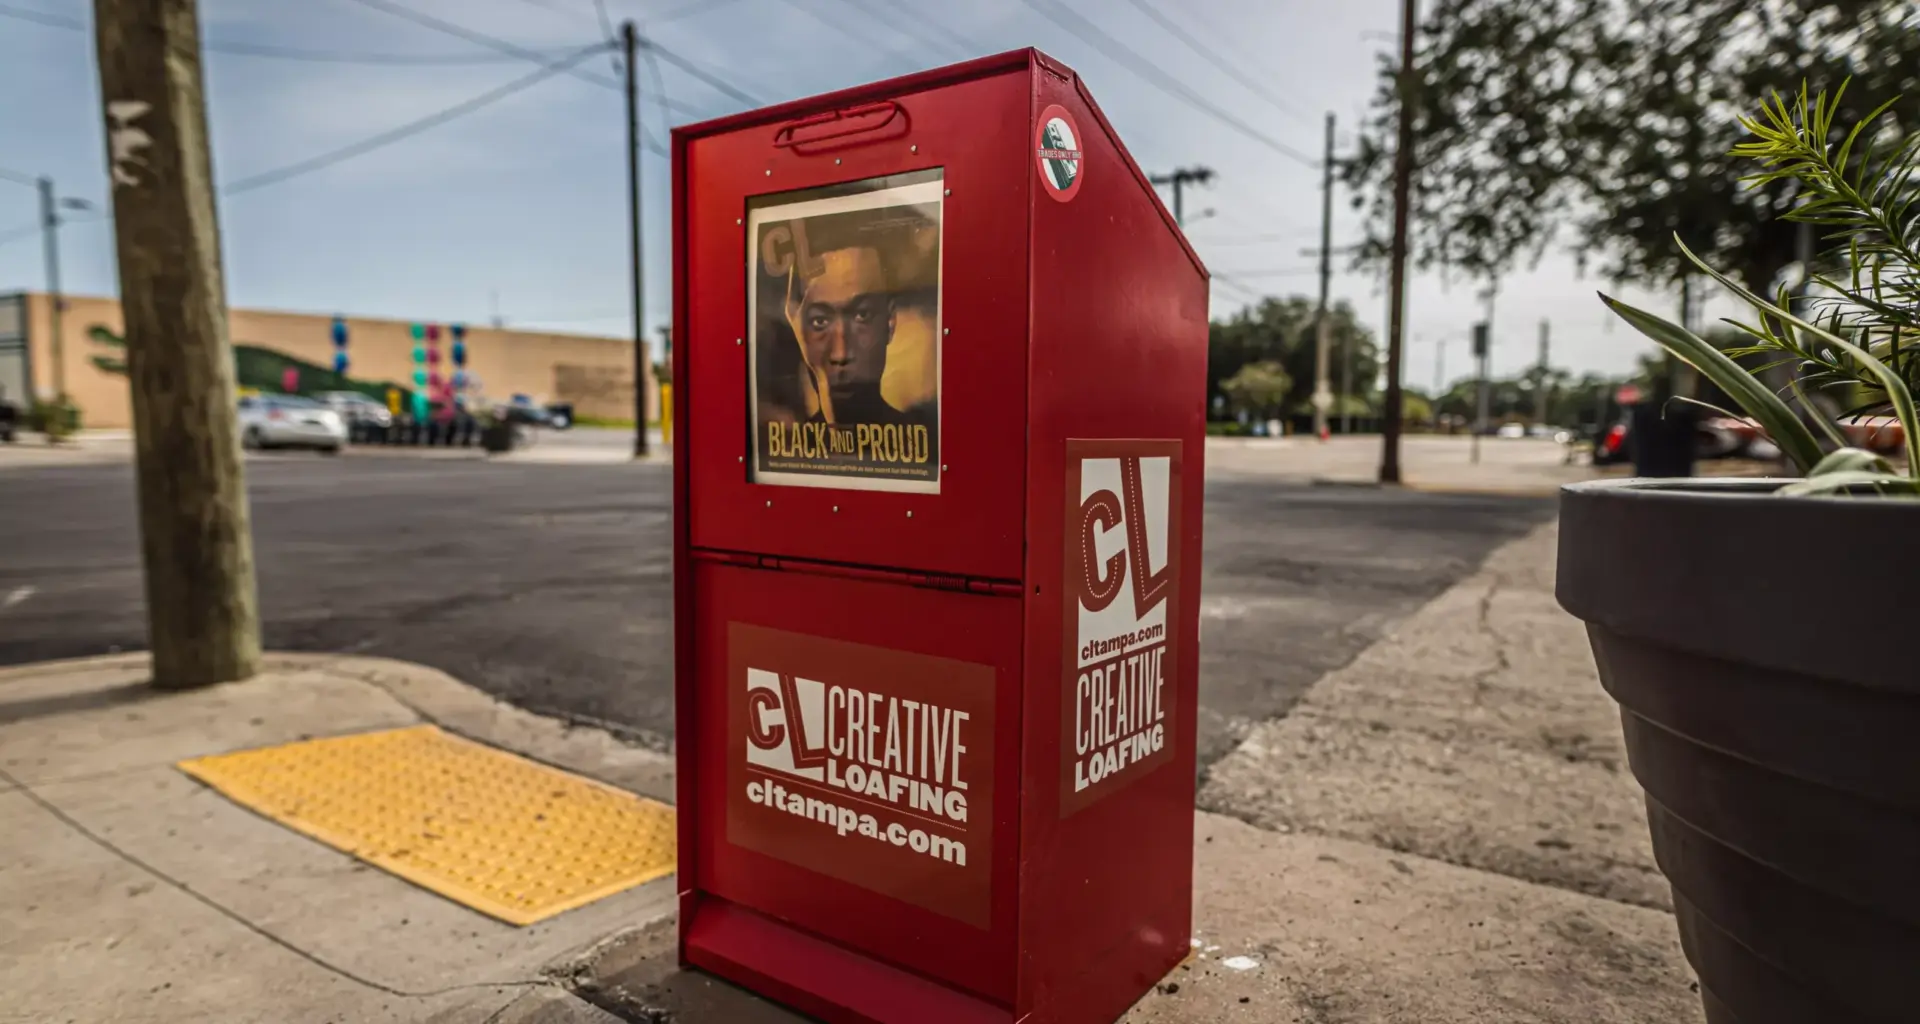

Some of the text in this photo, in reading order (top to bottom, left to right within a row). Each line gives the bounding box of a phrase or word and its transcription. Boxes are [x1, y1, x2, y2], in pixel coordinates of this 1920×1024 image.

[1037, 149, 1058, 158] TRADES
[1058, 150, 1072, 159] ONLY
[761, 219, 825, 277] CL
[768, 421, 928, 463] BLACK AND PROUD
[1079, 457, 1168, 621] CL
[1081, 623, 1163, 661] cltampa.com
[747, 669, 825, 772] CL
[1076, 646, 1166, 756] CREATIVE
[828, 685, 970, 790] CREATIVE
[1075, 723, 1164, 792] LOAFING
[746, 779, 967, 867] cltampa.com
[827, 758, 968, 823] LOAFING
